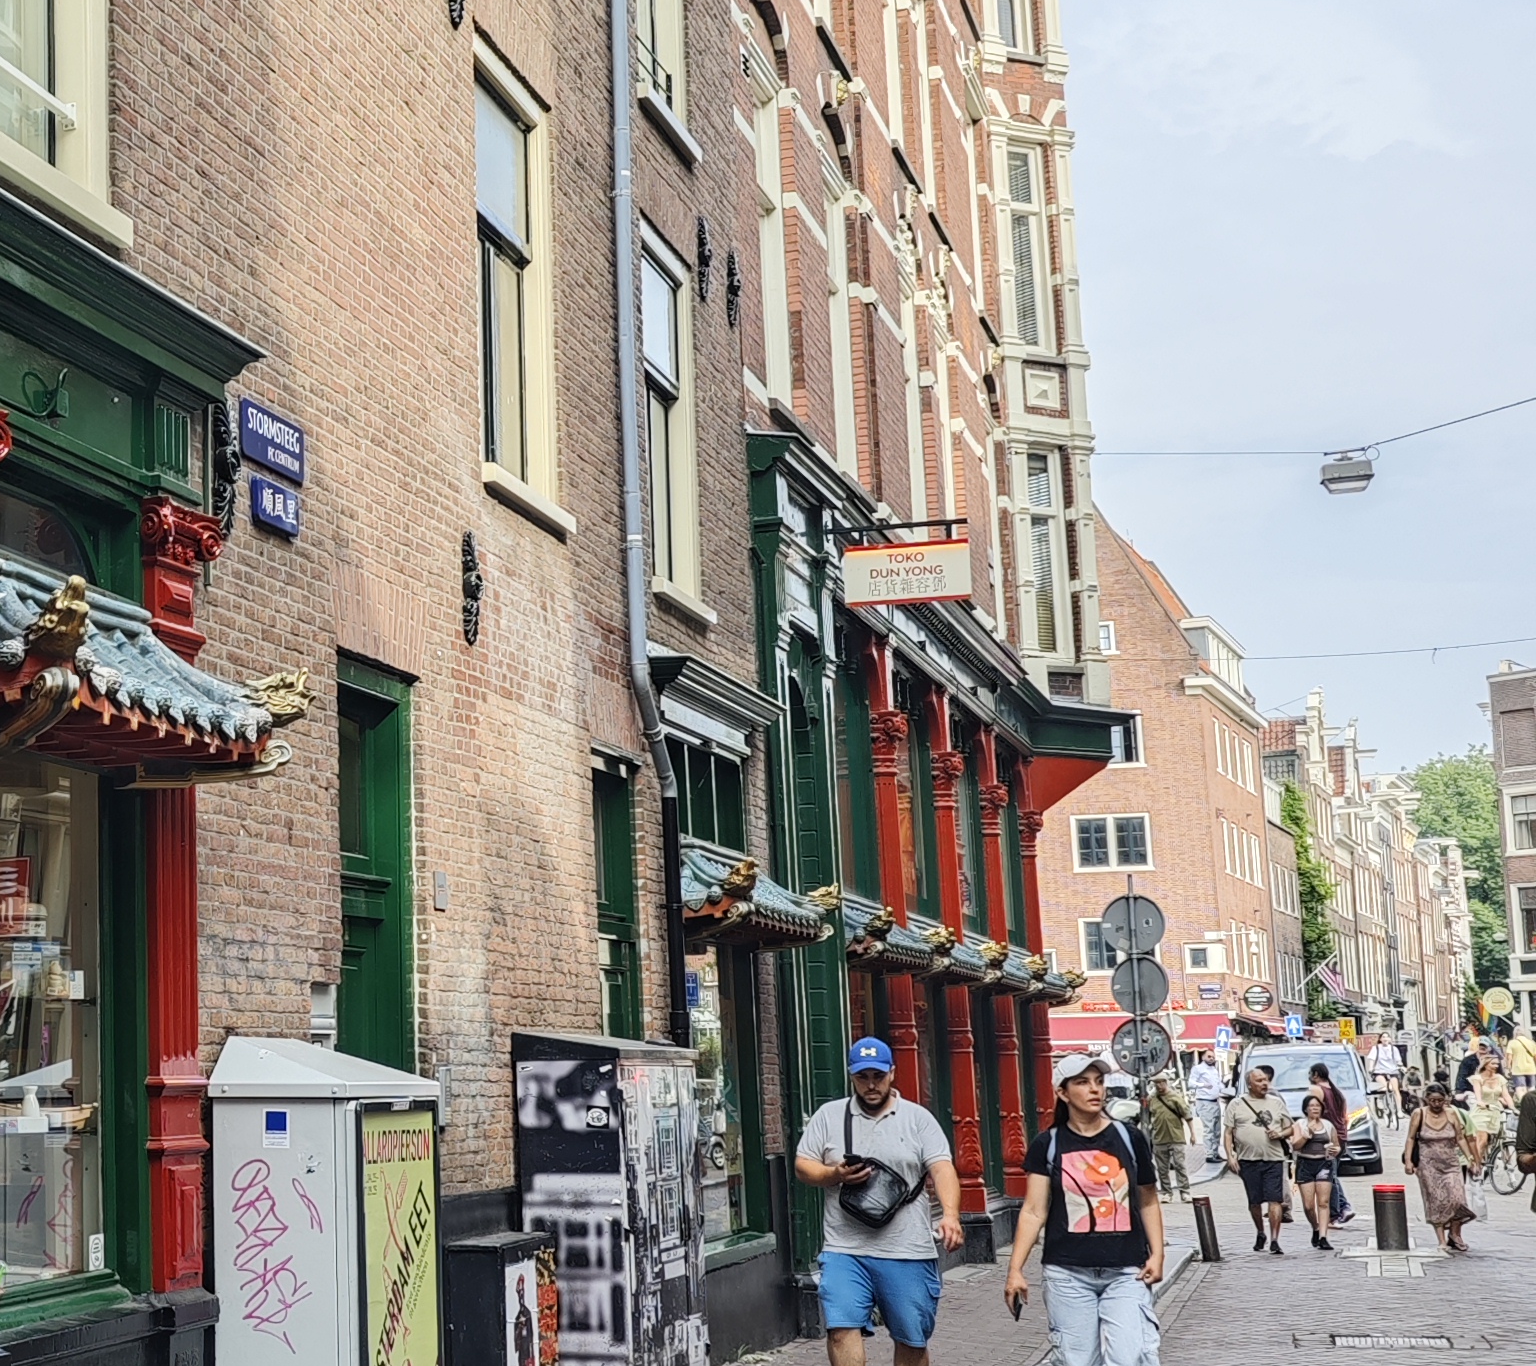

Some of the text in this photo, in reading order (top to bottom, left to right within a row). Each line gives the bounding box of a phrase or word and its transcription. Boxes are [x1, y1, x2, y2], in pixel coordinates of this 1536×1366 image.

[247, 406, 300, 454] STORMSTEEG
[275, 450, 300, 474] CENTRUM
[262, 487, 297, 525] 順風里
[870, 565, 944, 579] DUN YONG
[887, 552, 925, 564] TOKO
[408, 1180, 431, 1250] EET
